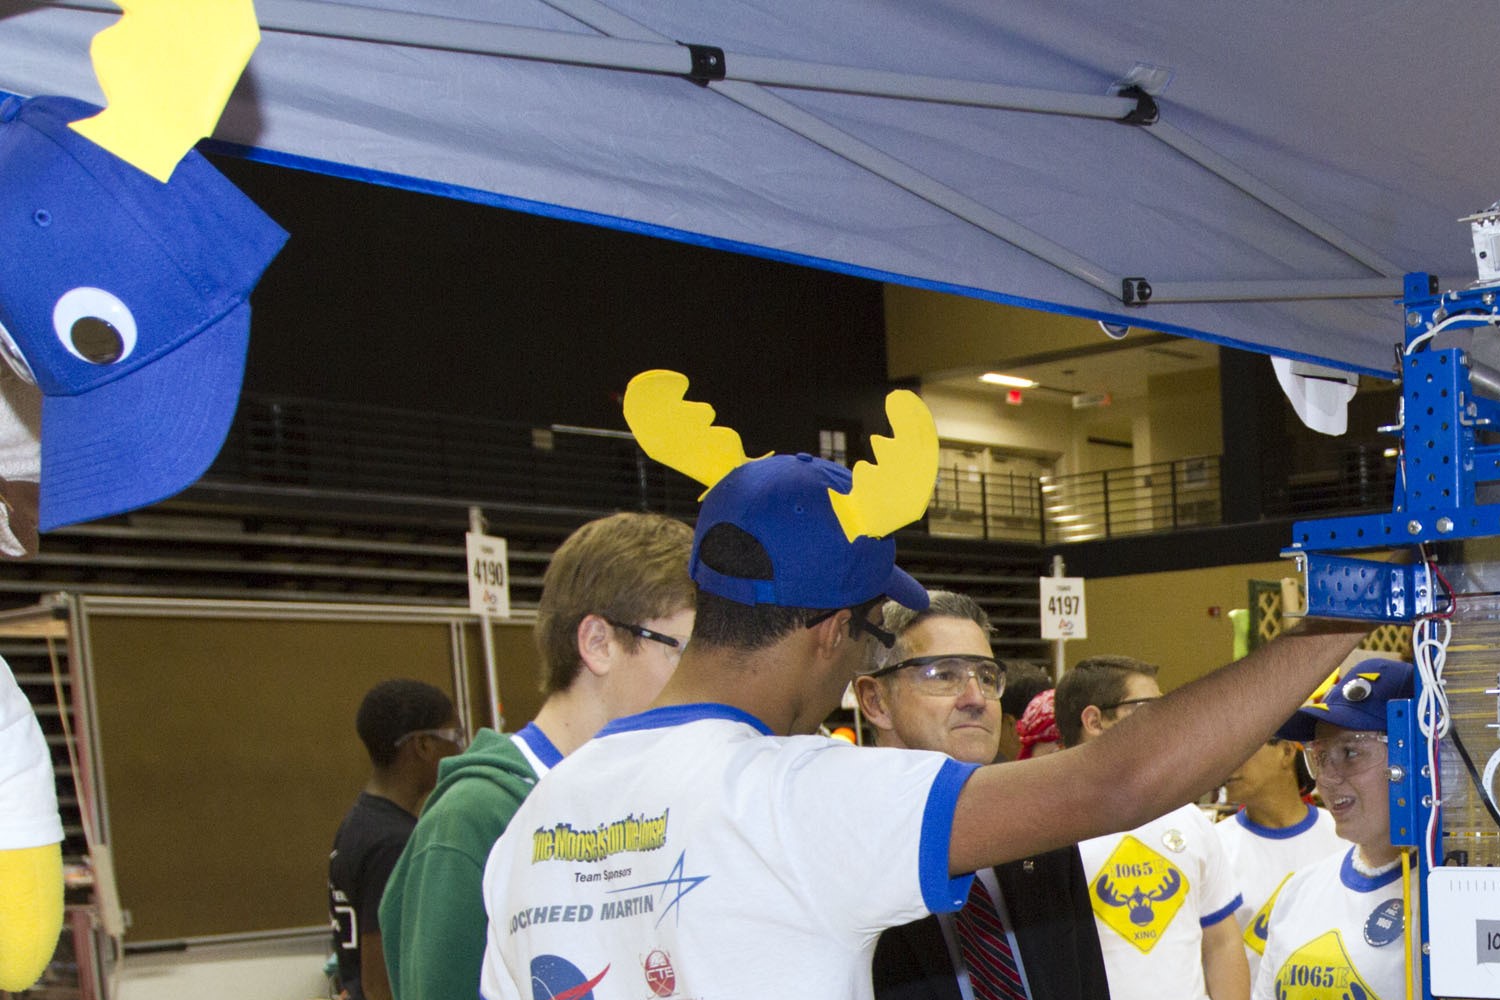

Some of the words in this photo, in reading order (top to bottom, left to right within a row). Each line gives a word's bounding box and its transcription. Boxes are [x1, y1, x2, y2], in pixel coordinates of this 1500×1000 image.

[473, 559, 503, 588] 4190
[1048, 595, 1080, 615] 4197
[574, 872, 602, 883] Team
[600, 894, 654, 921] MARTIN
[1134, 930, 1157, 940] XING
[646, 966, 674, 982] CTE
